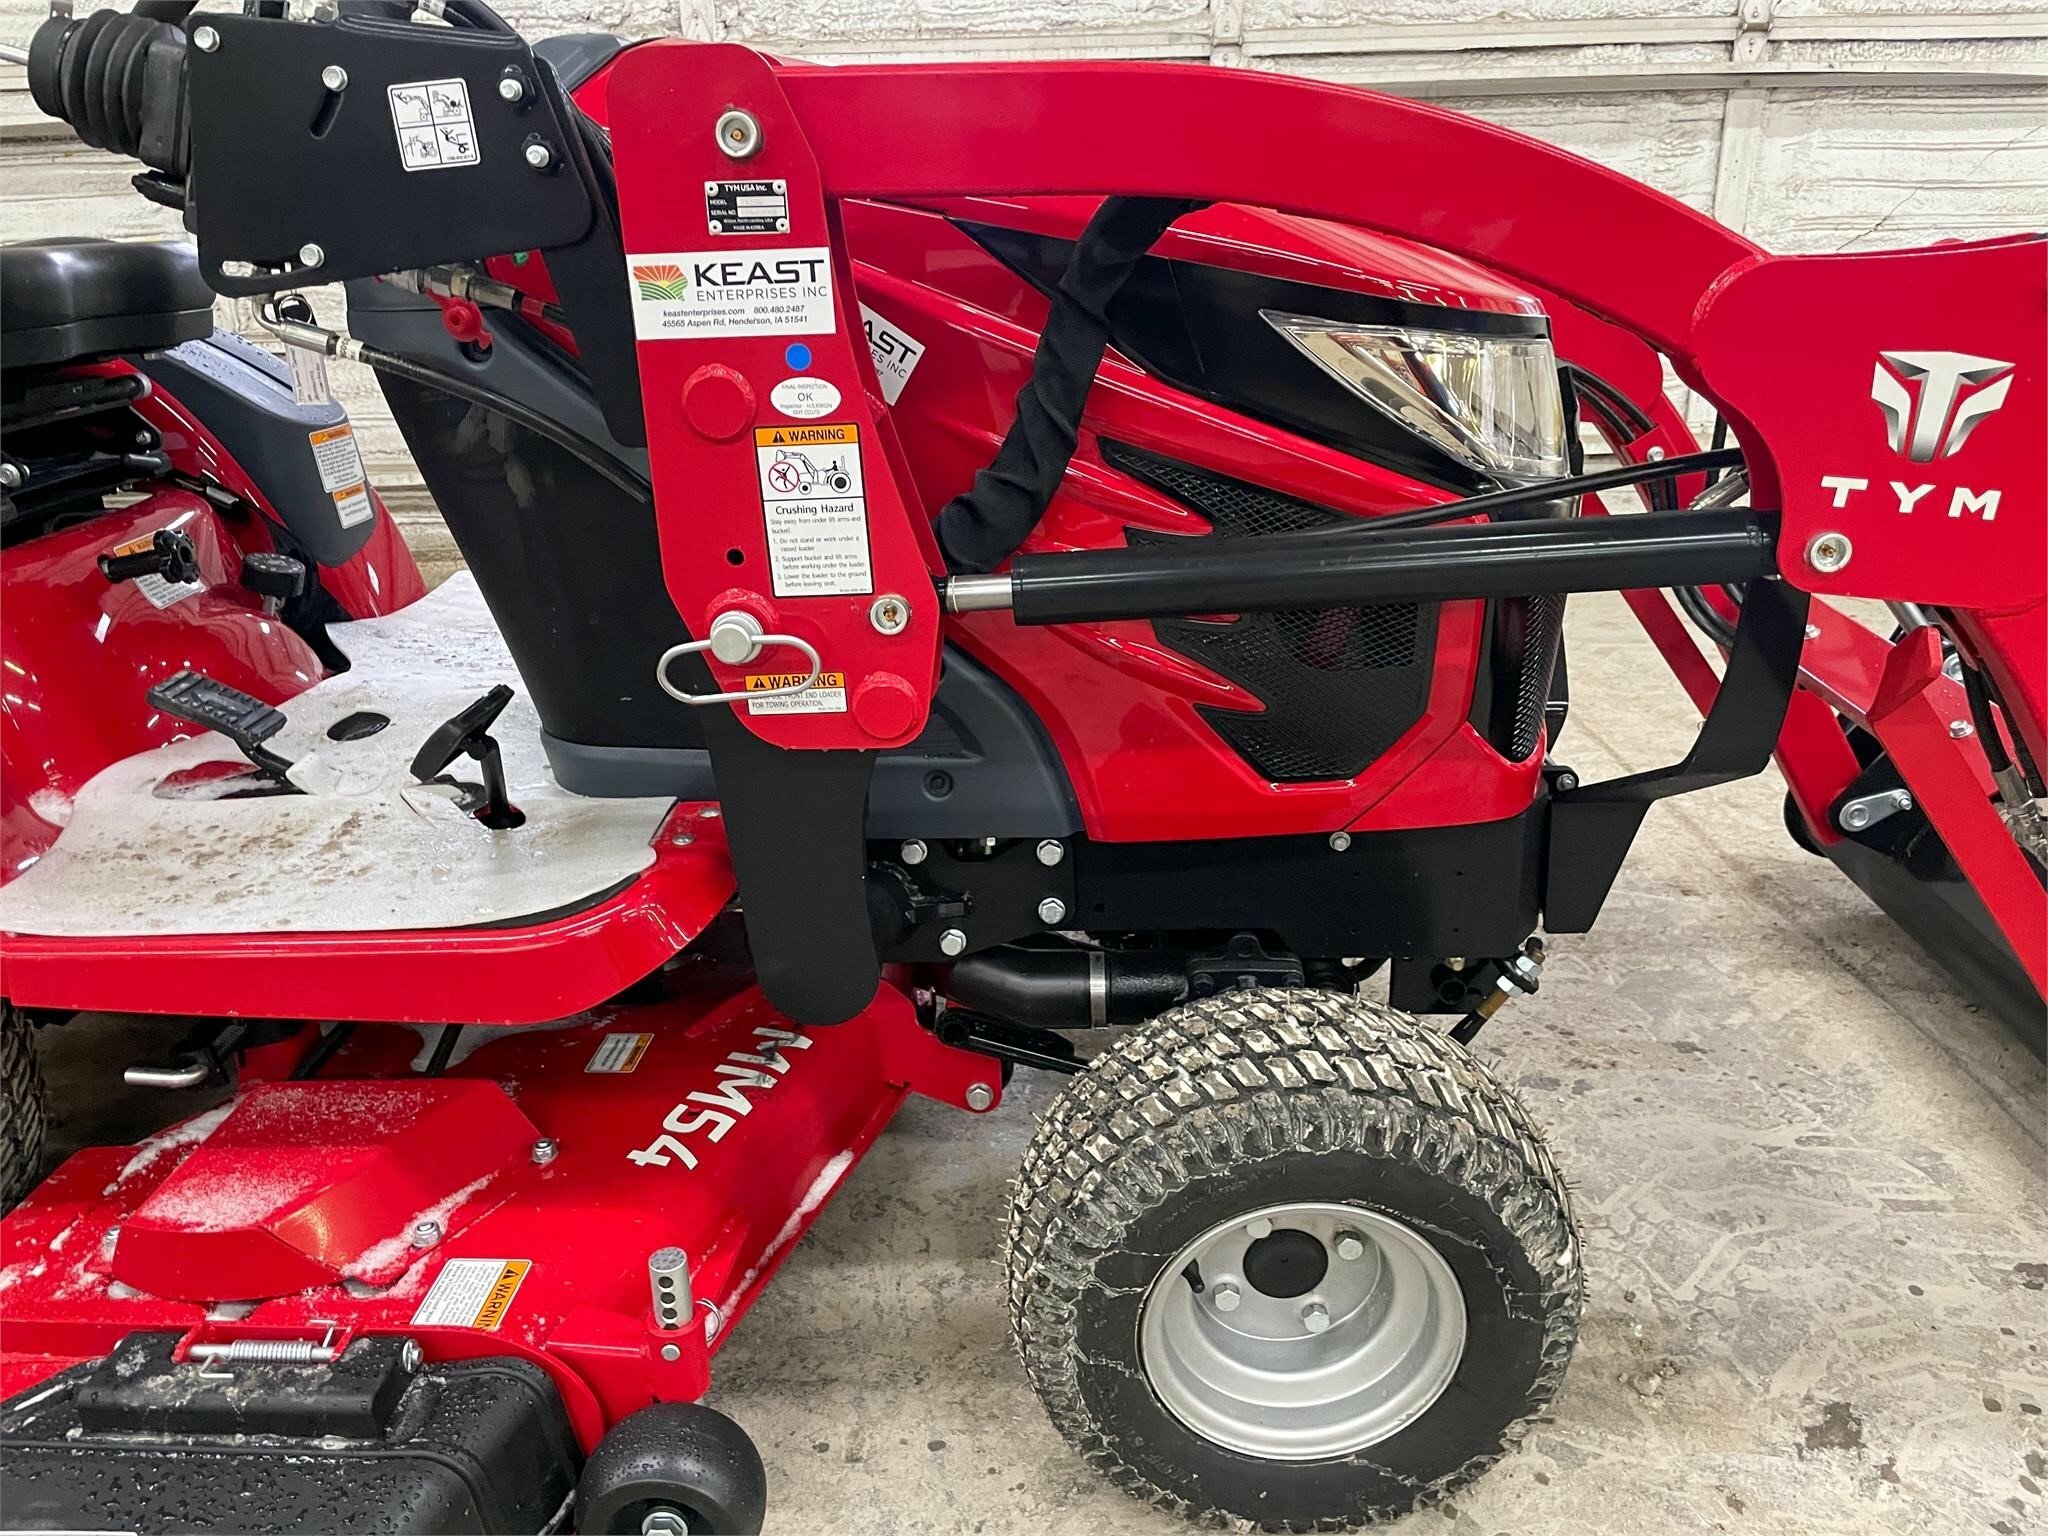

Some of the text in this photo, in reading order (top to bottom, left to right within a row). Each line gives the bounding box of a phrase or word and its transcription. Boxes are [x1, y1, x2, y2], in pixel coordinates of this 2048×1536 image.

[694, 260, 824, 287] KEAST
[696, 286, 828, 302] ENTERPRISES INC
[663, 305, 804, 317] keastenterprises.com 800.480.2487
[687, 319, 711, 328] Aspen
[714, 318, 727, 327] Rd,
[728, 317, 773, 326] Henderson,
[785, 316, 807, 324] 51541
[864, 320, 917, 364] AST
[886, 361, 906, 378] INC
[797, 393, 813, 401] OK
[789, 429, 845, 442] WARNING
[1820, 476, 2002, 520] TYM
[776, 503, 854, 515] Crushing Hazard
[768, 674, 836, 689] WARNNG
[626, 1027, 813, 1171] MM54
[478, 1283, 513, 1332] WARNIN
